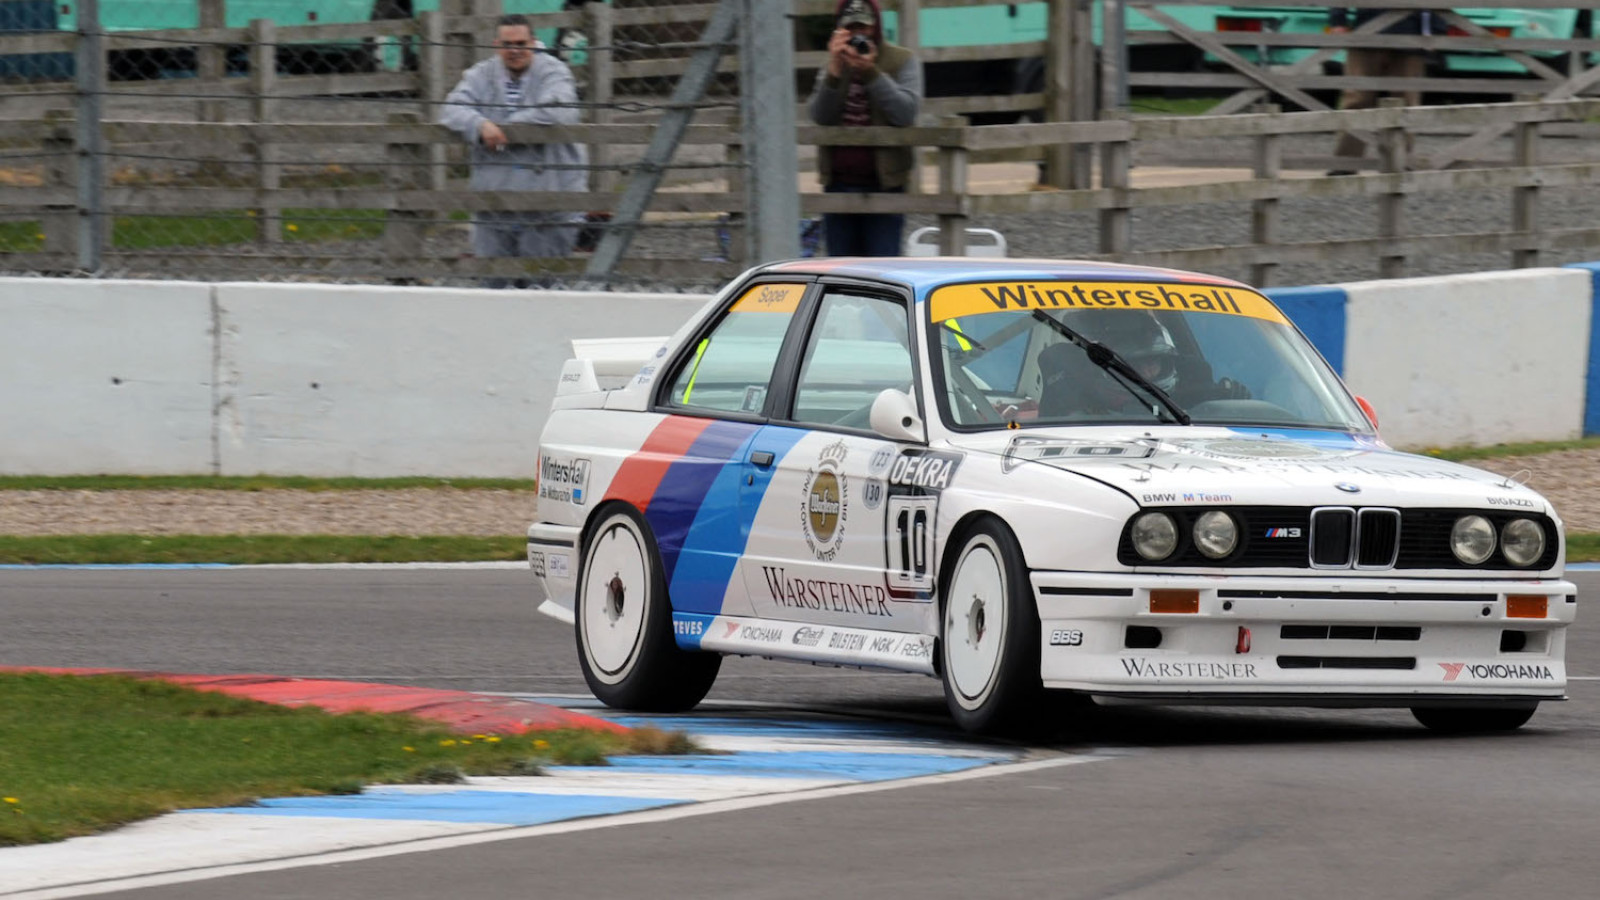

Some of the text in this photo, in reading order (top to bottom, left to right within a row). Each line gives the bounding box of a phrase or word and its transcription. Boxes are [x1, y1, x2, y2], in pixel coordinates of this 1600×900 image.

[758, 286, 790, 308] Soper
[981, 284, 1243, 315] Wintershall
[890, 455, 953, 489] DEKRA
[865, 483, 880, 502] 130
[1142, 493, 1233, 503] BMW M Team
[1486, 496, 1535, 508] BIGAZZI
[1275, 527, 1302, 538] M3
[896, 507, 928, 581] 10
[762, 566, 893, 618] WARSTEINER
[673, 621, 703, 636] TEVES
[740, 625, 783, 643] YOKOHAMA
[828, 631, 867, 651] BILSTEIN
[870, 637, 895, 653] NGK
[1050, 630, 1083, 646] BBS
[1121, 657, 1258, 679] WARSTEINER
[1466, 664, 1555, 681] YOKOHAMA
